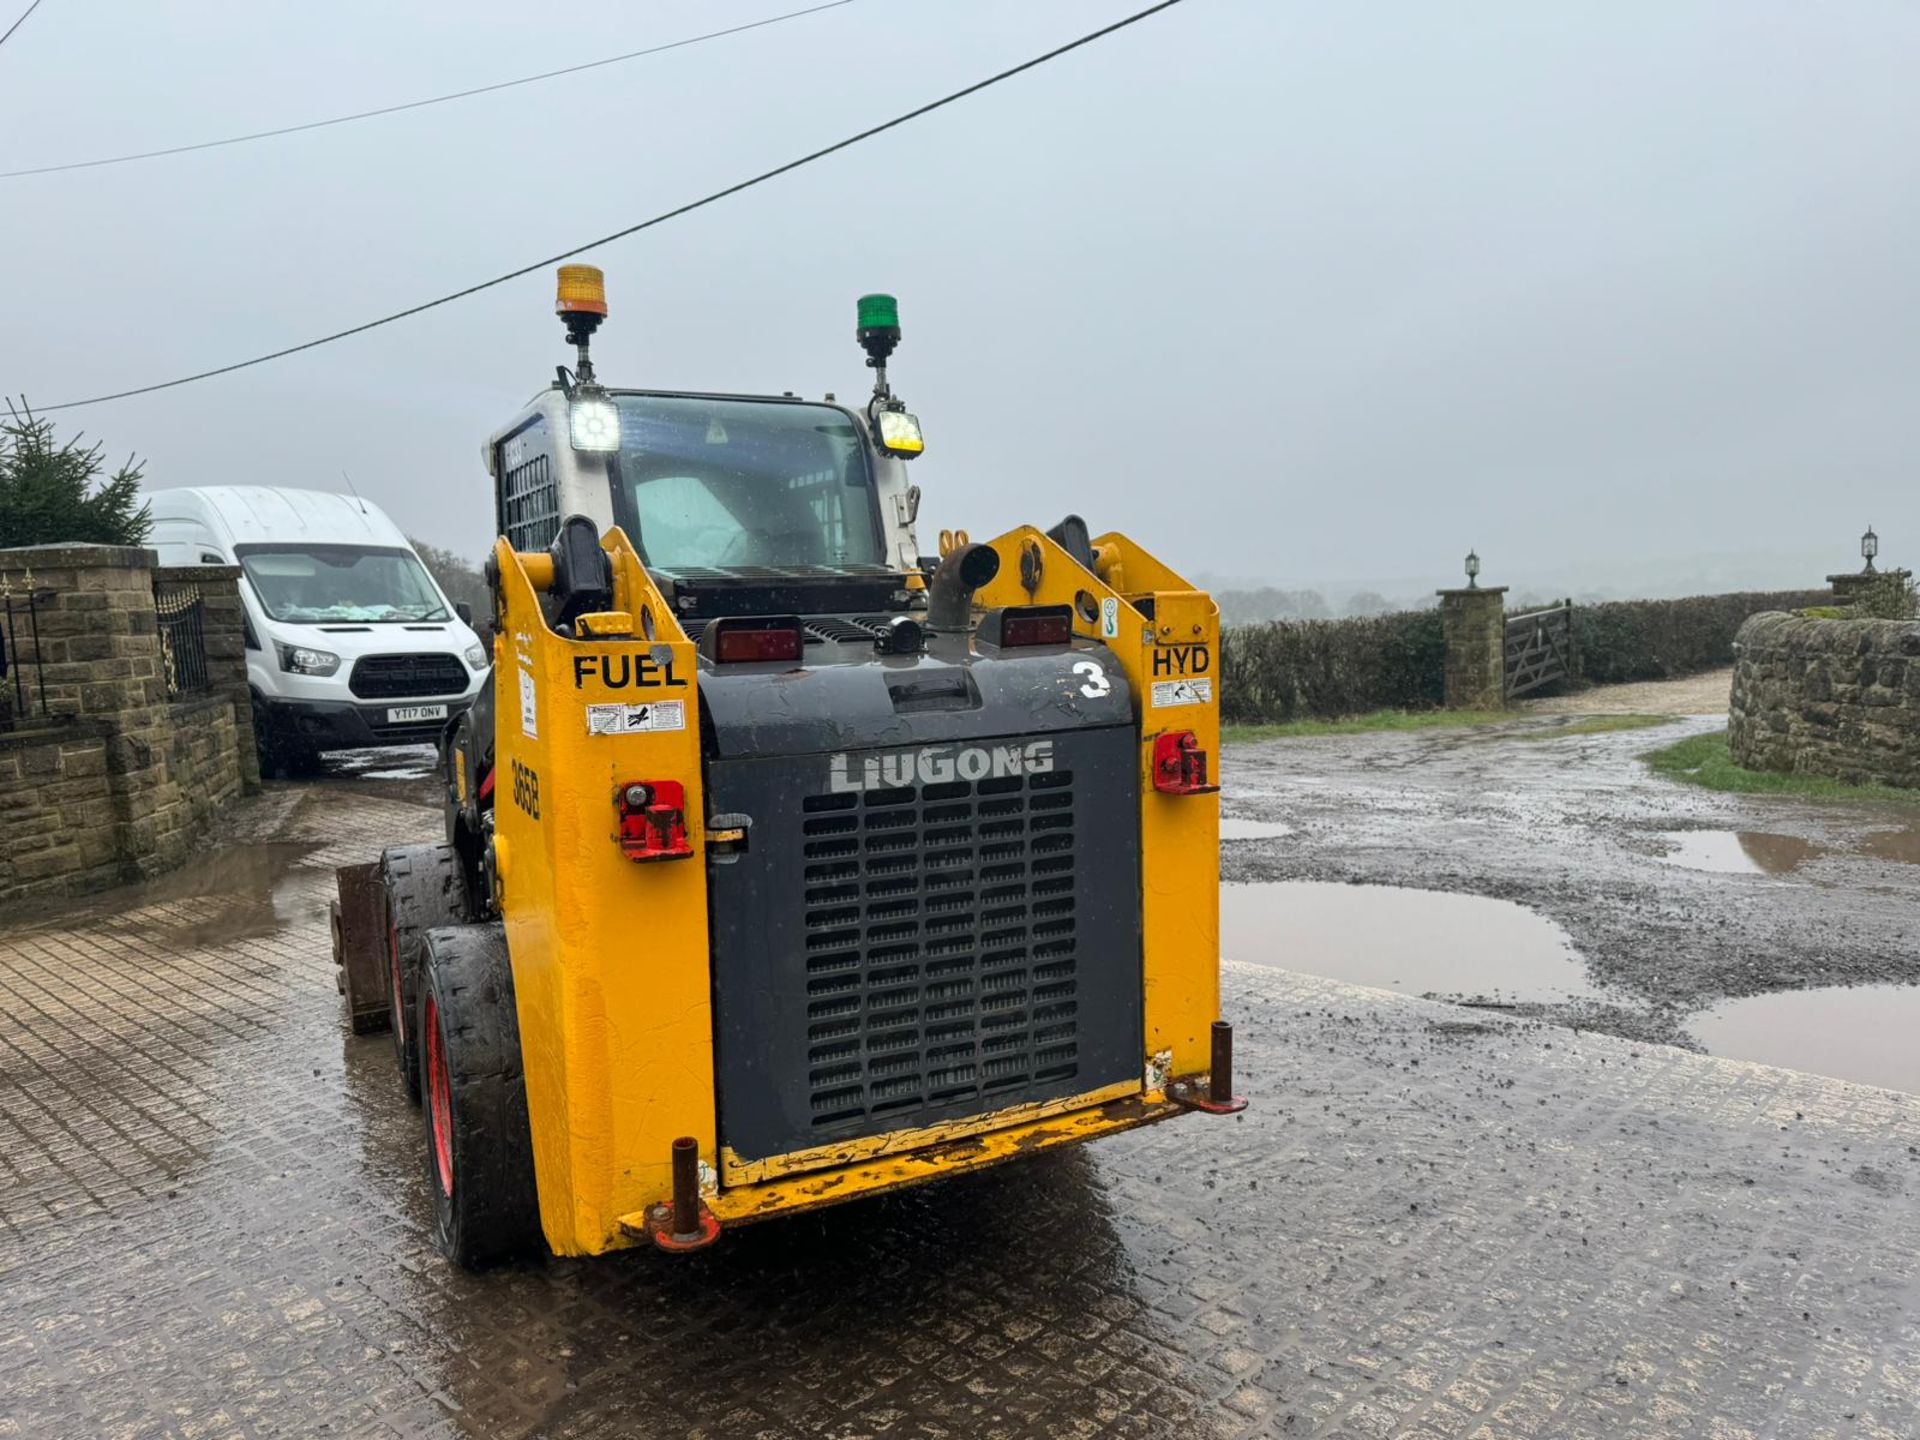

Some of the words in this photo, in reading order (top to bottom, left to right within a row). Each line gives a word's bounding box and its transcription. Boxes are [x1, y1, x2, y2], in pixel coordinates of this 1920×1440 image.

[573, 654, 689, 689] FUEL
[1153, 646, 1209, 676] HYD
[1073, 661, 1110, 698] 3
[394, 708, 418, 720] YT17
[421, 706, 440, 718] ONV
[830, 741, 1054, 793] LIUGONG
[512, 758, 540, 821] 365B
